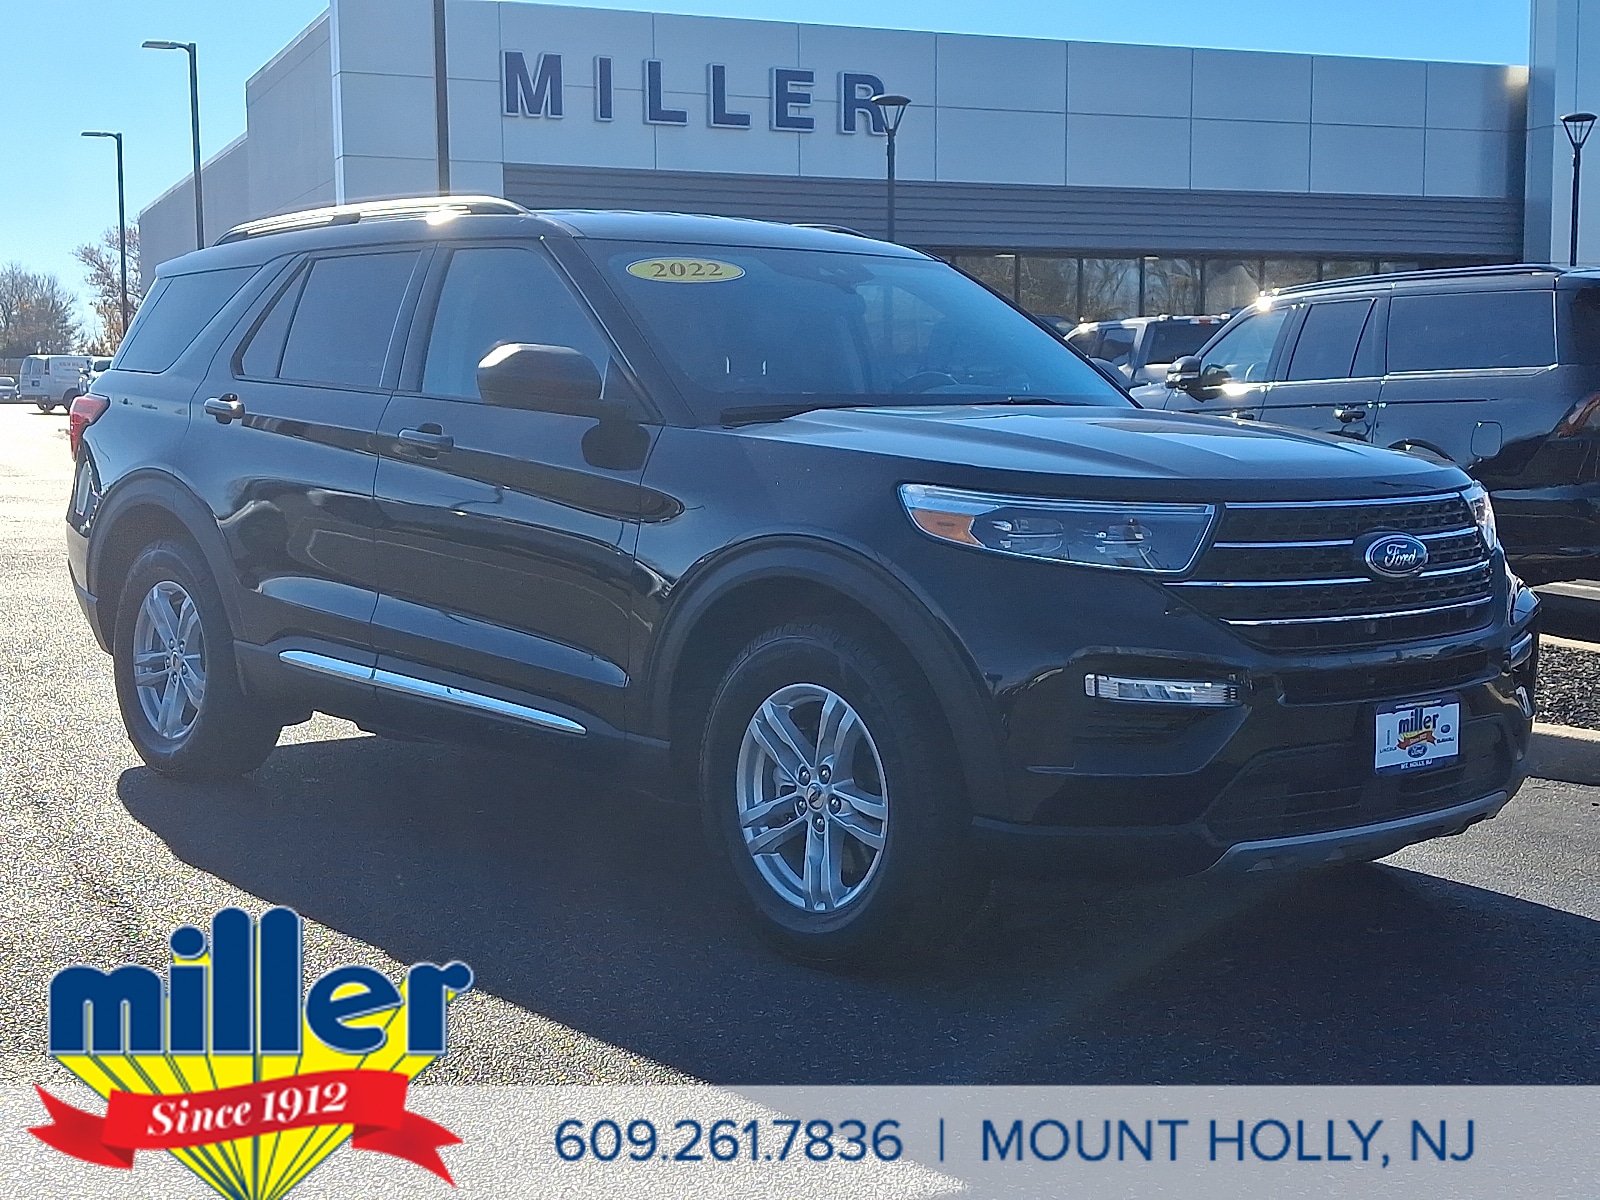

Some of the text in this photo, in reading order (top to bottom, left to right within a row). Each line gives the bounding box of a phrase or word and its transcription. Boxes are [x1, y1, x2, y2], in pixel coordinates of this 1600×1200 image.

[501, 50, 888, 136] MILLER
[651, 263, 723, 277] 2022
[1385, 544, 1417, 567] Ford
[1399, 708, 1439, 733] miller
